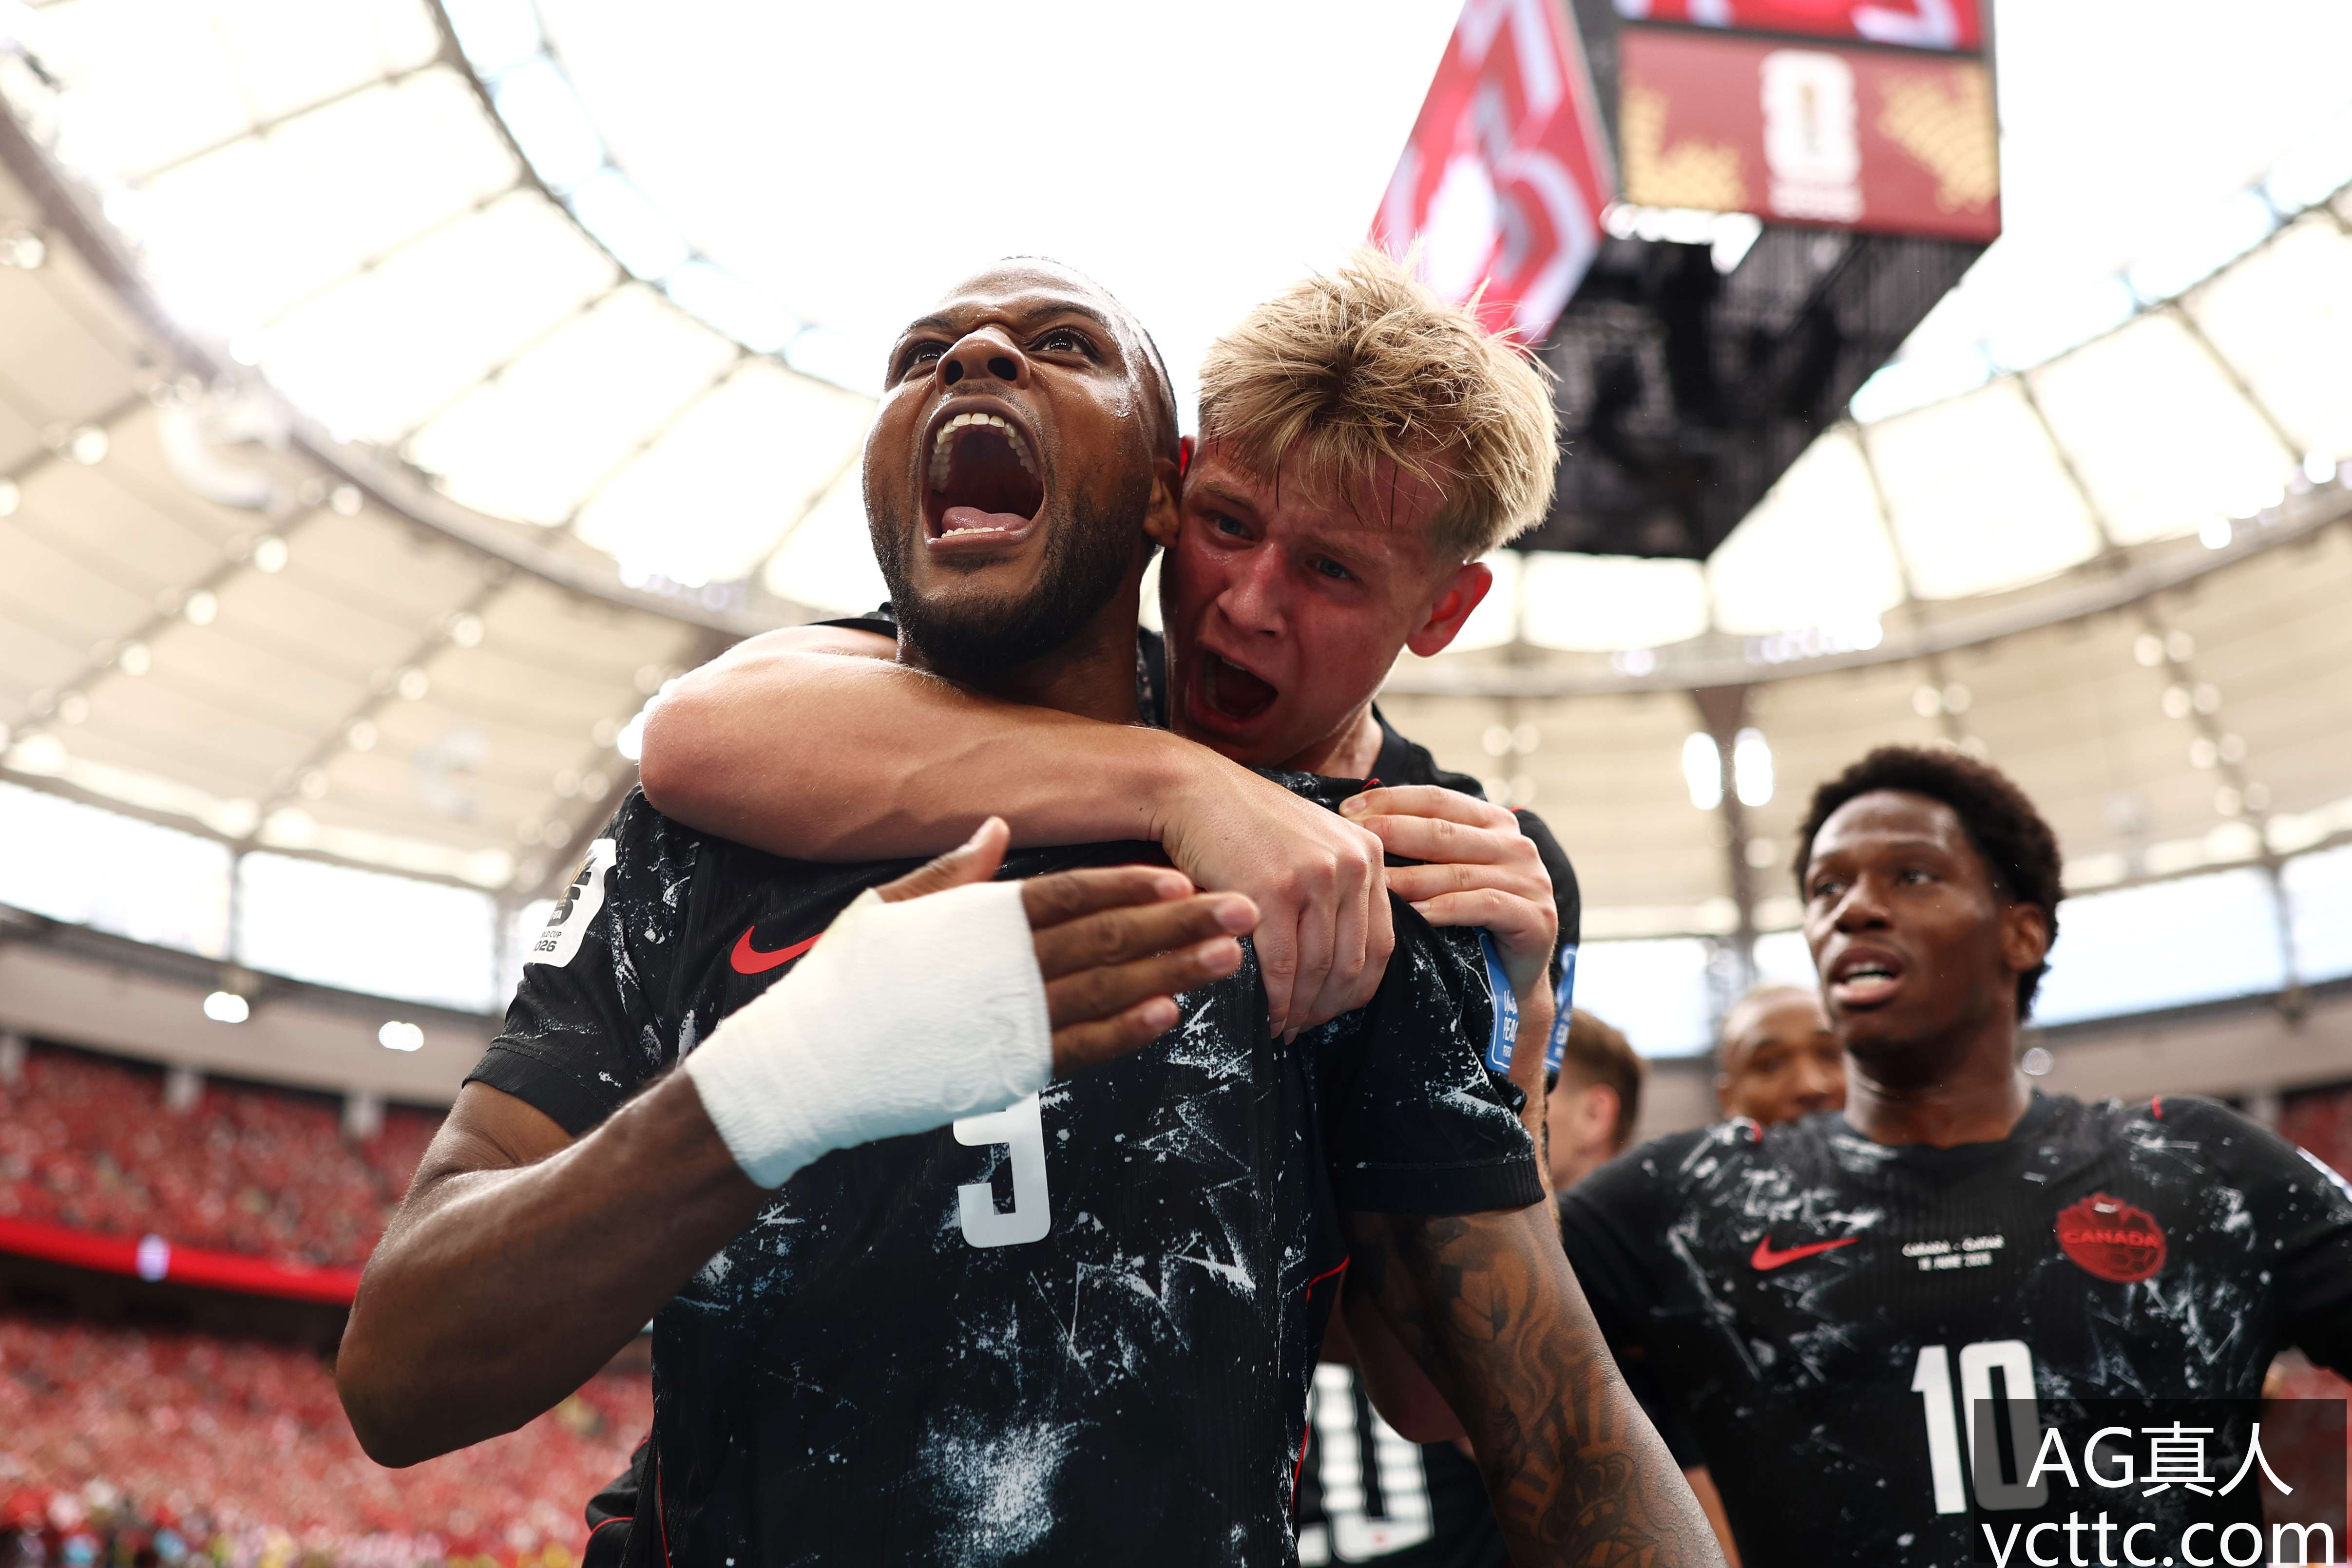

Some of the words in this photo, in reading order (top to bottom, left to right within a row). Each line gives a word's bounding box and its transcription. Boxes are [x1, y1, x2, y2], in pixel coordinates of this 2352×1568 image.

[534, 940, 557, 952] 026
[2062, 1228, 2161, 1250] CANADA
[1910, 1339, 2049, 1514] 10
